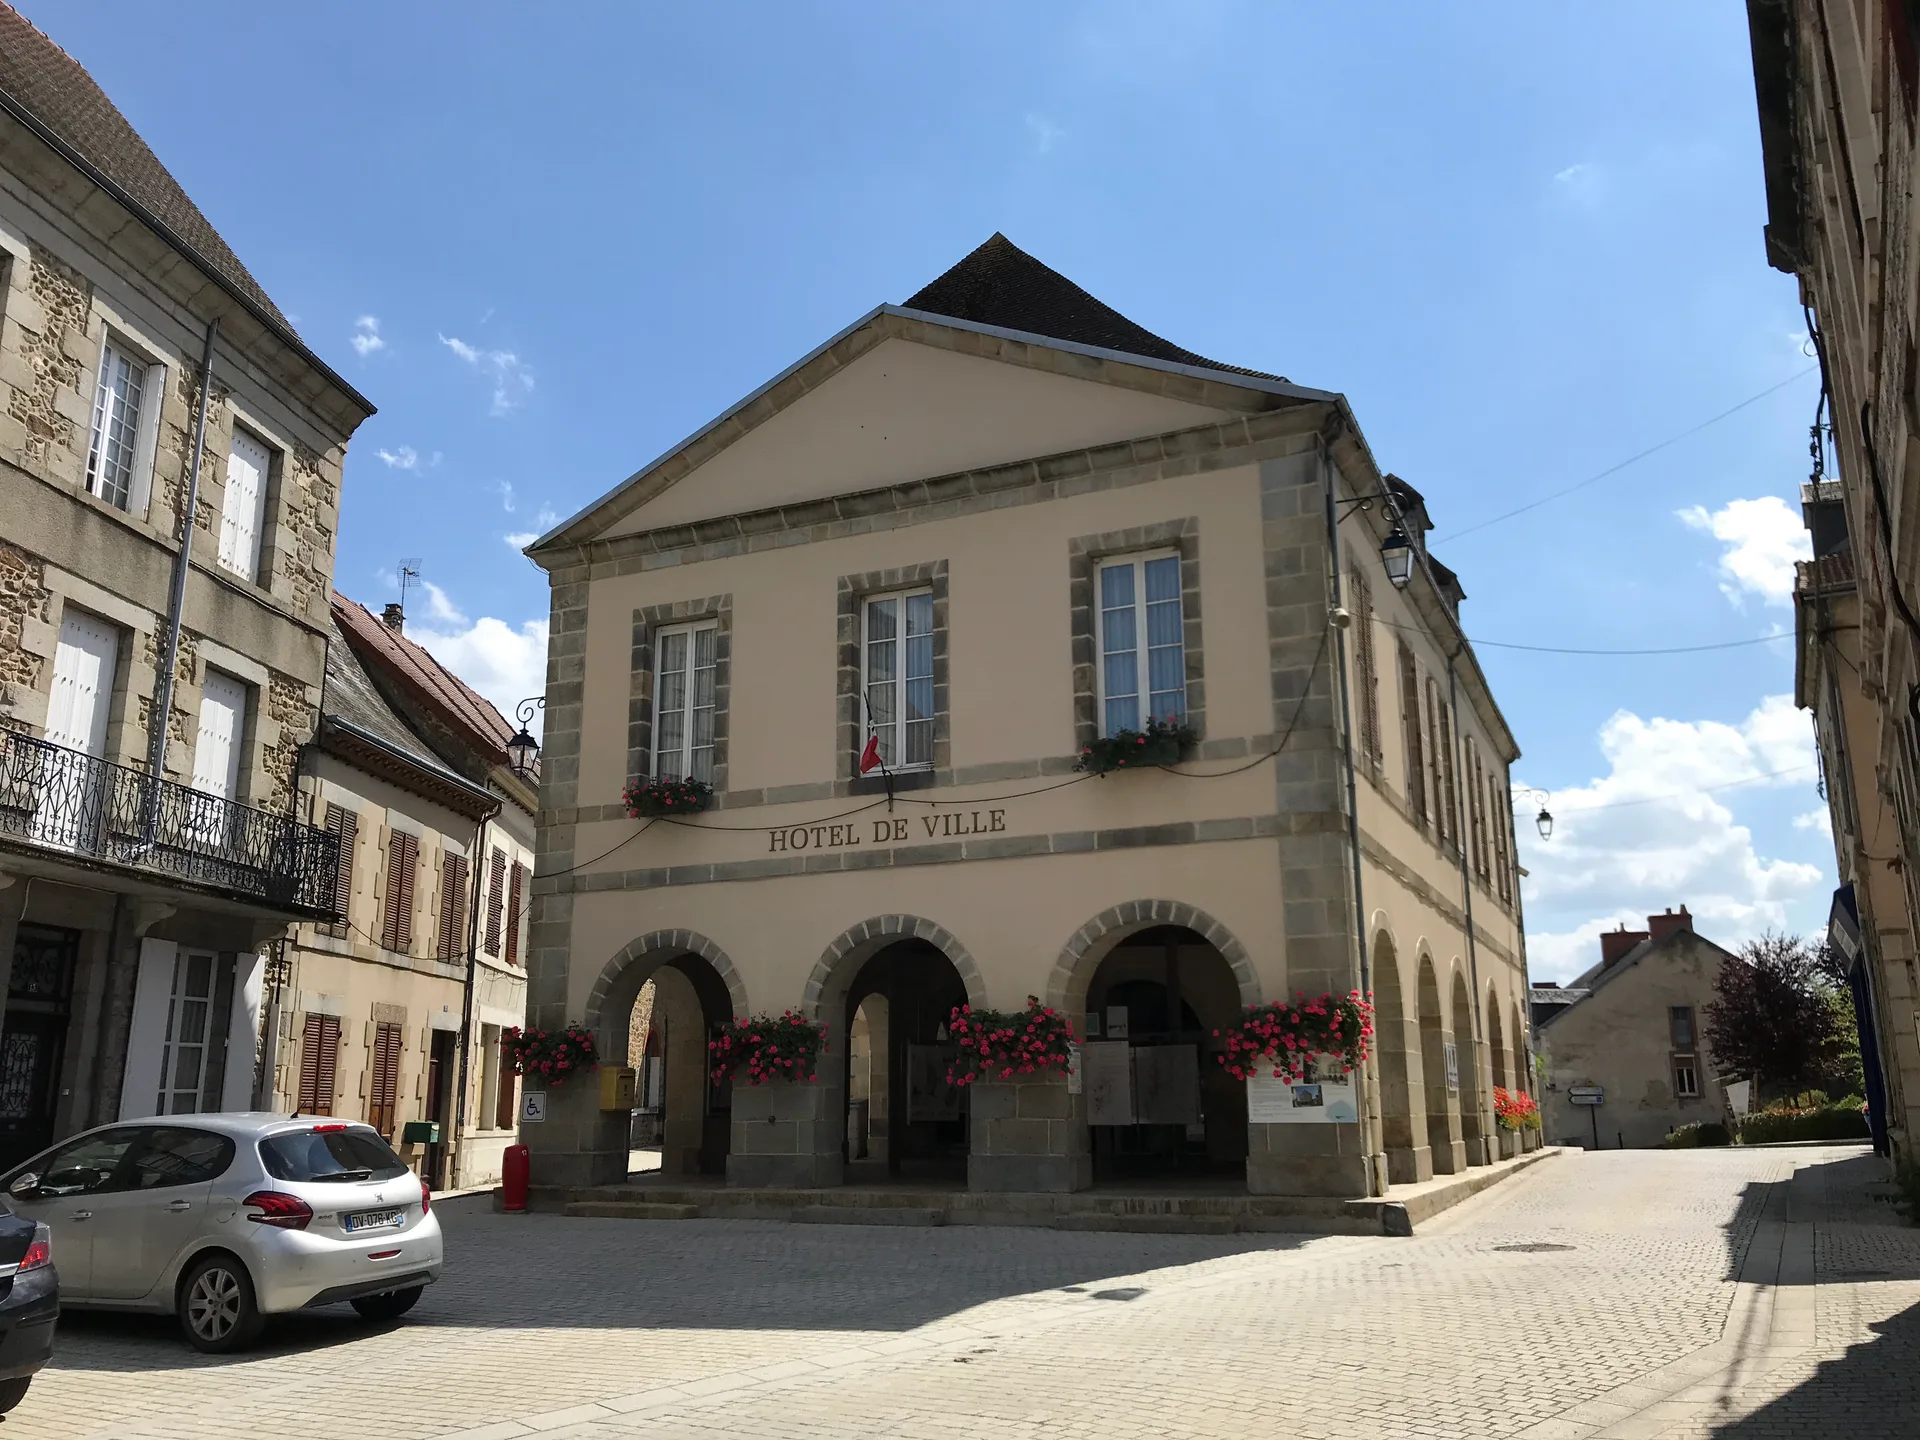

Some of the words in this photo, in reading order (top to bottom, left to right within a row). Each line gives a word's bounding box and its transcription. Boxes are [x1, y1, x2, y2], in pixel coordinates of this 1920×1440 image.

[769, 823, 860, 852] HOTEL
[872, 818, 908, 843] DE
[921, 809, 1006, 838] VILLE
